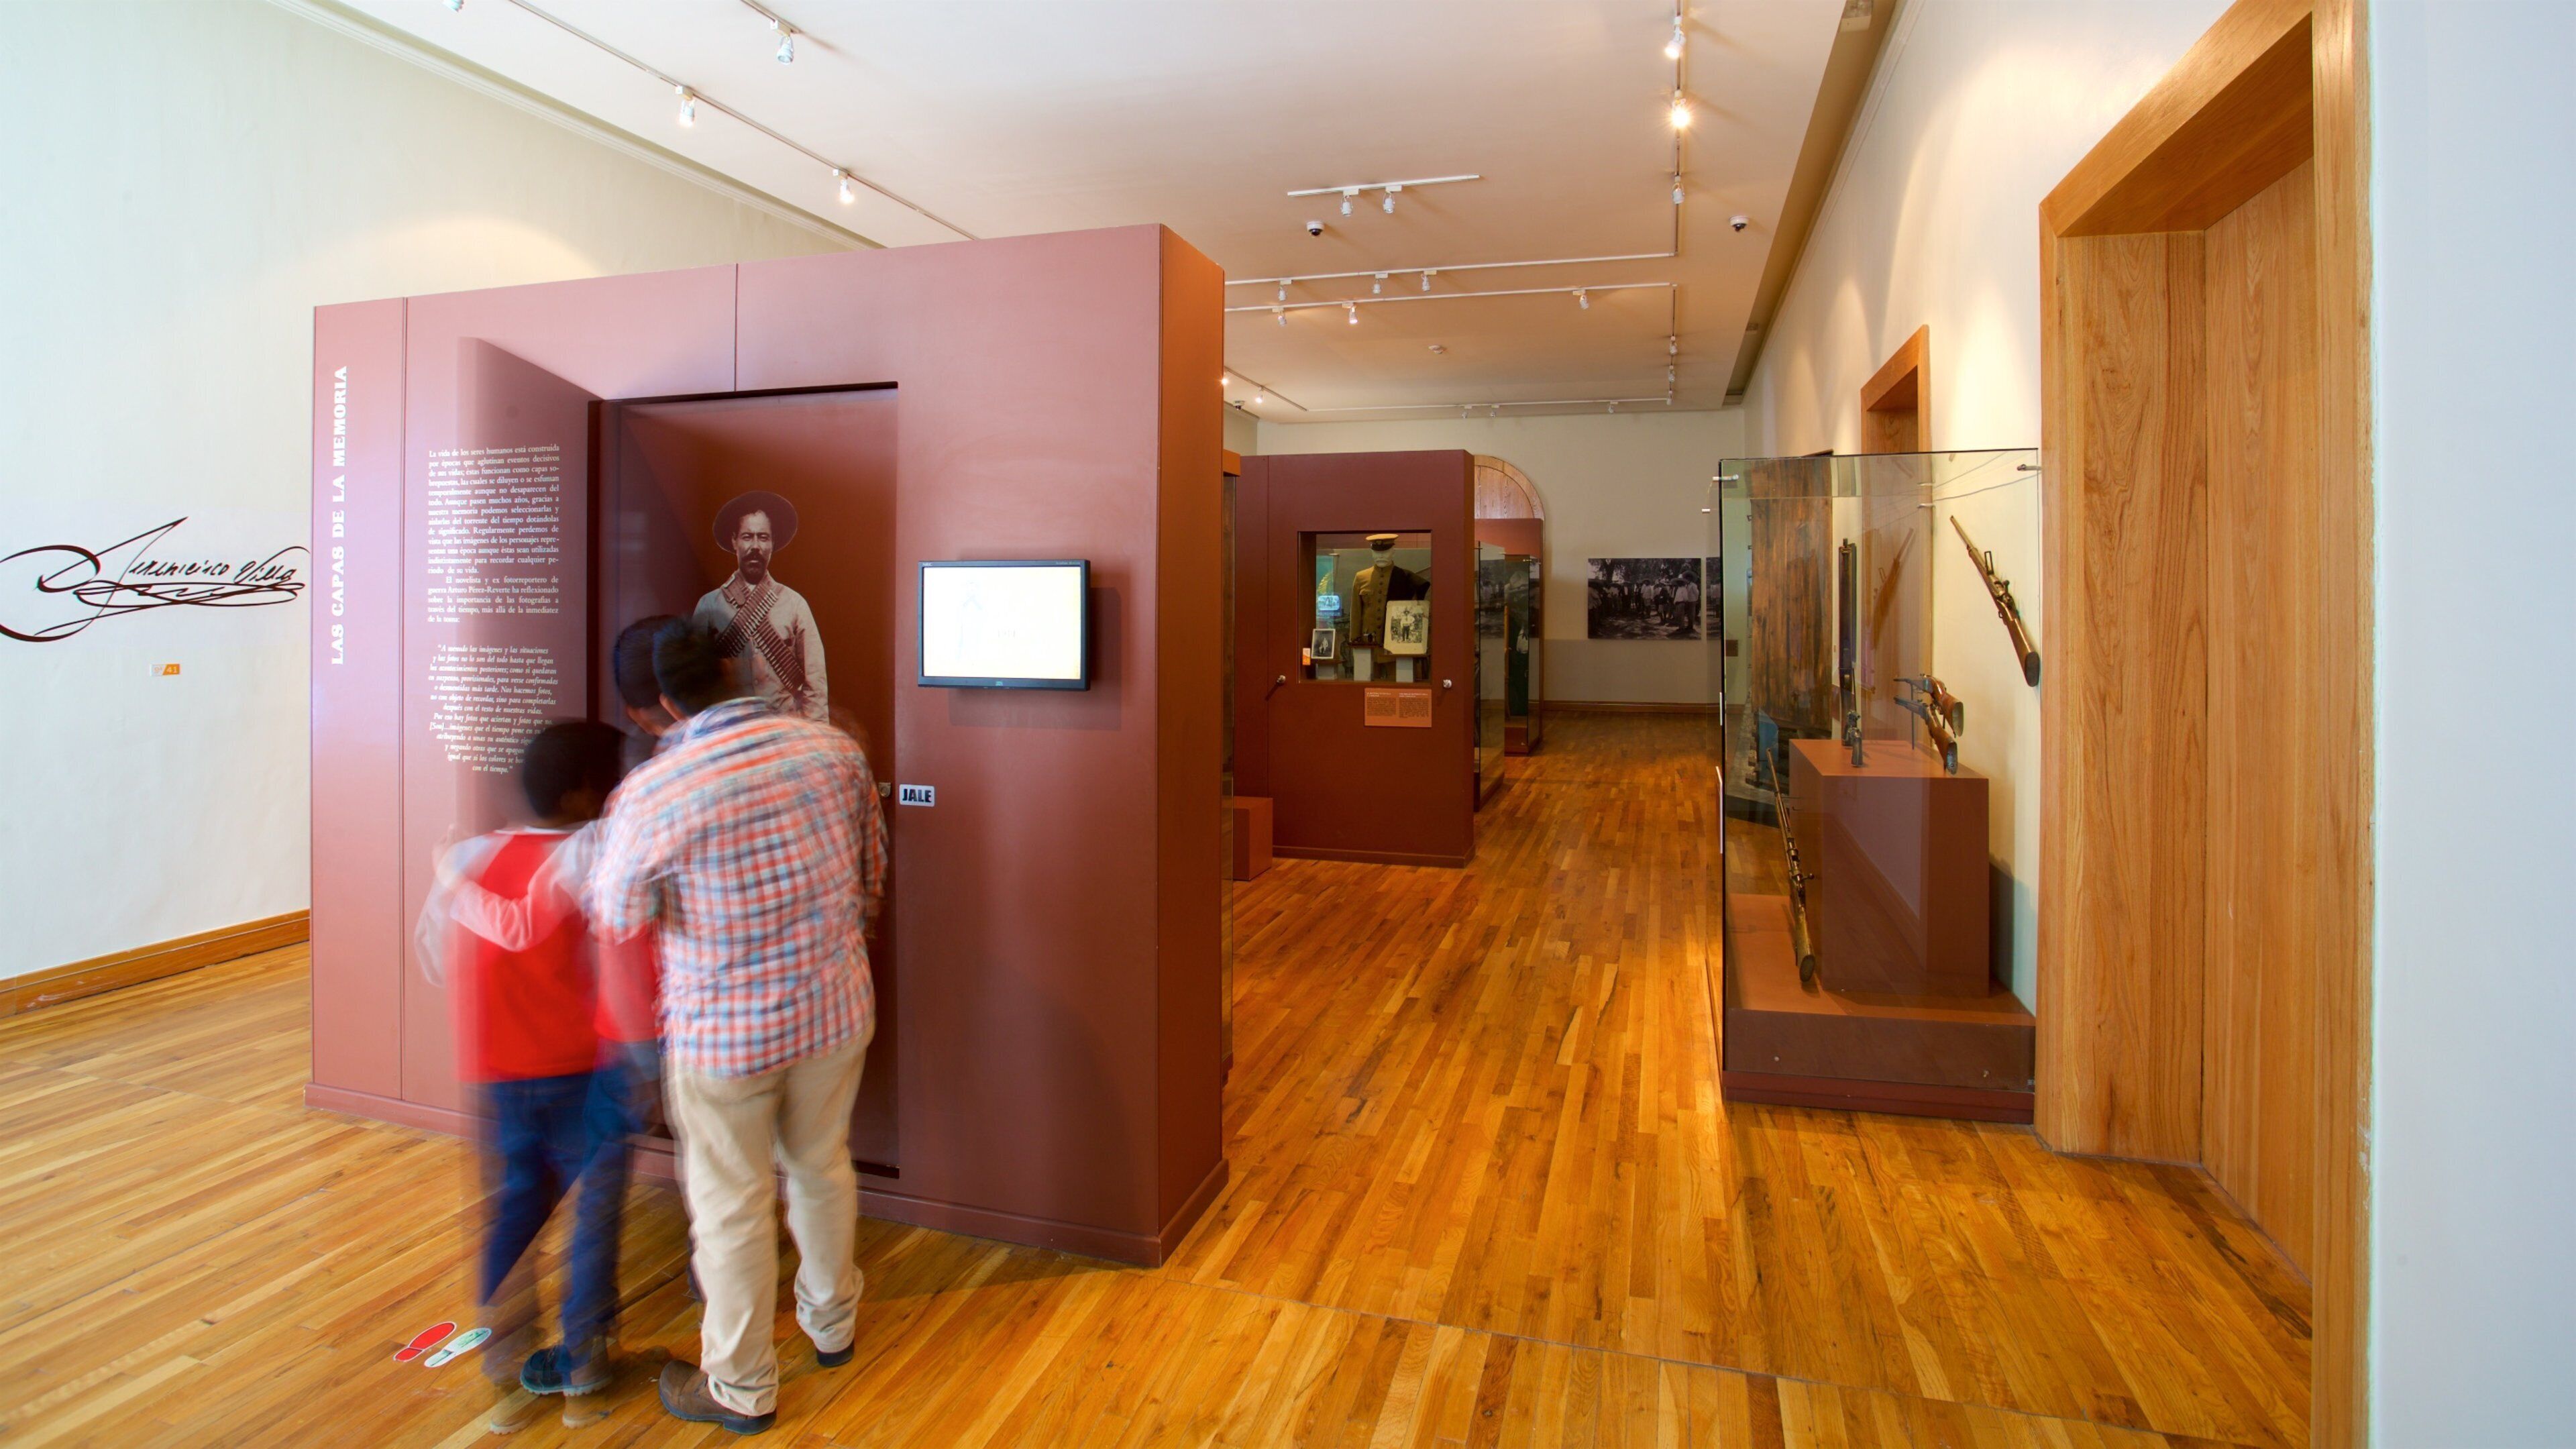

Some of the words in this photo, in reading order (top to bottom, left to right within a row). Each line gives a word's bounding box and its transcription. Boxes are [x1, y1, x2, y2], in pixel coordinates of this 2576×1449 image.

[333, 366, 347, 466] MEMORIA
[528, 443, 559, 452] construida
[482, 466, 511, 474] funcionan
[497, 476, 519, 485] diluyen
[534, 474, 559, 482] esfuman
[333, 474, 345, 502] LA
[511, 486, 546, 494] desaparecen
[489, 496, 511, 504] muchos
[532, 495, 552, 504] gracias
[481, 506, 508, 516] podemos
[332, 510, 344, 537] DE
[502, 516, 523, 525] tiempo
[474, 527, 515, 535] Regularmente
[519, 526, 547, 535] perdemos
[509, 536, 539, 545] personajes
[518, 555, 545, 565] cualquier
[331, 546, 344, 616] CAPAS
[504, 576, 547, 585] fotorreportero
[521, 585, 559, 593] reflexionado
[331, 624, 343, 665] LAS
[537, 657, 553, 665] llegan
[532, 667, 556, 676] quedaran
[514, 685, 536, 694] hacemos
[523, 697, 556, 706] completarlas
[902, 788, 932, 803] JALE
